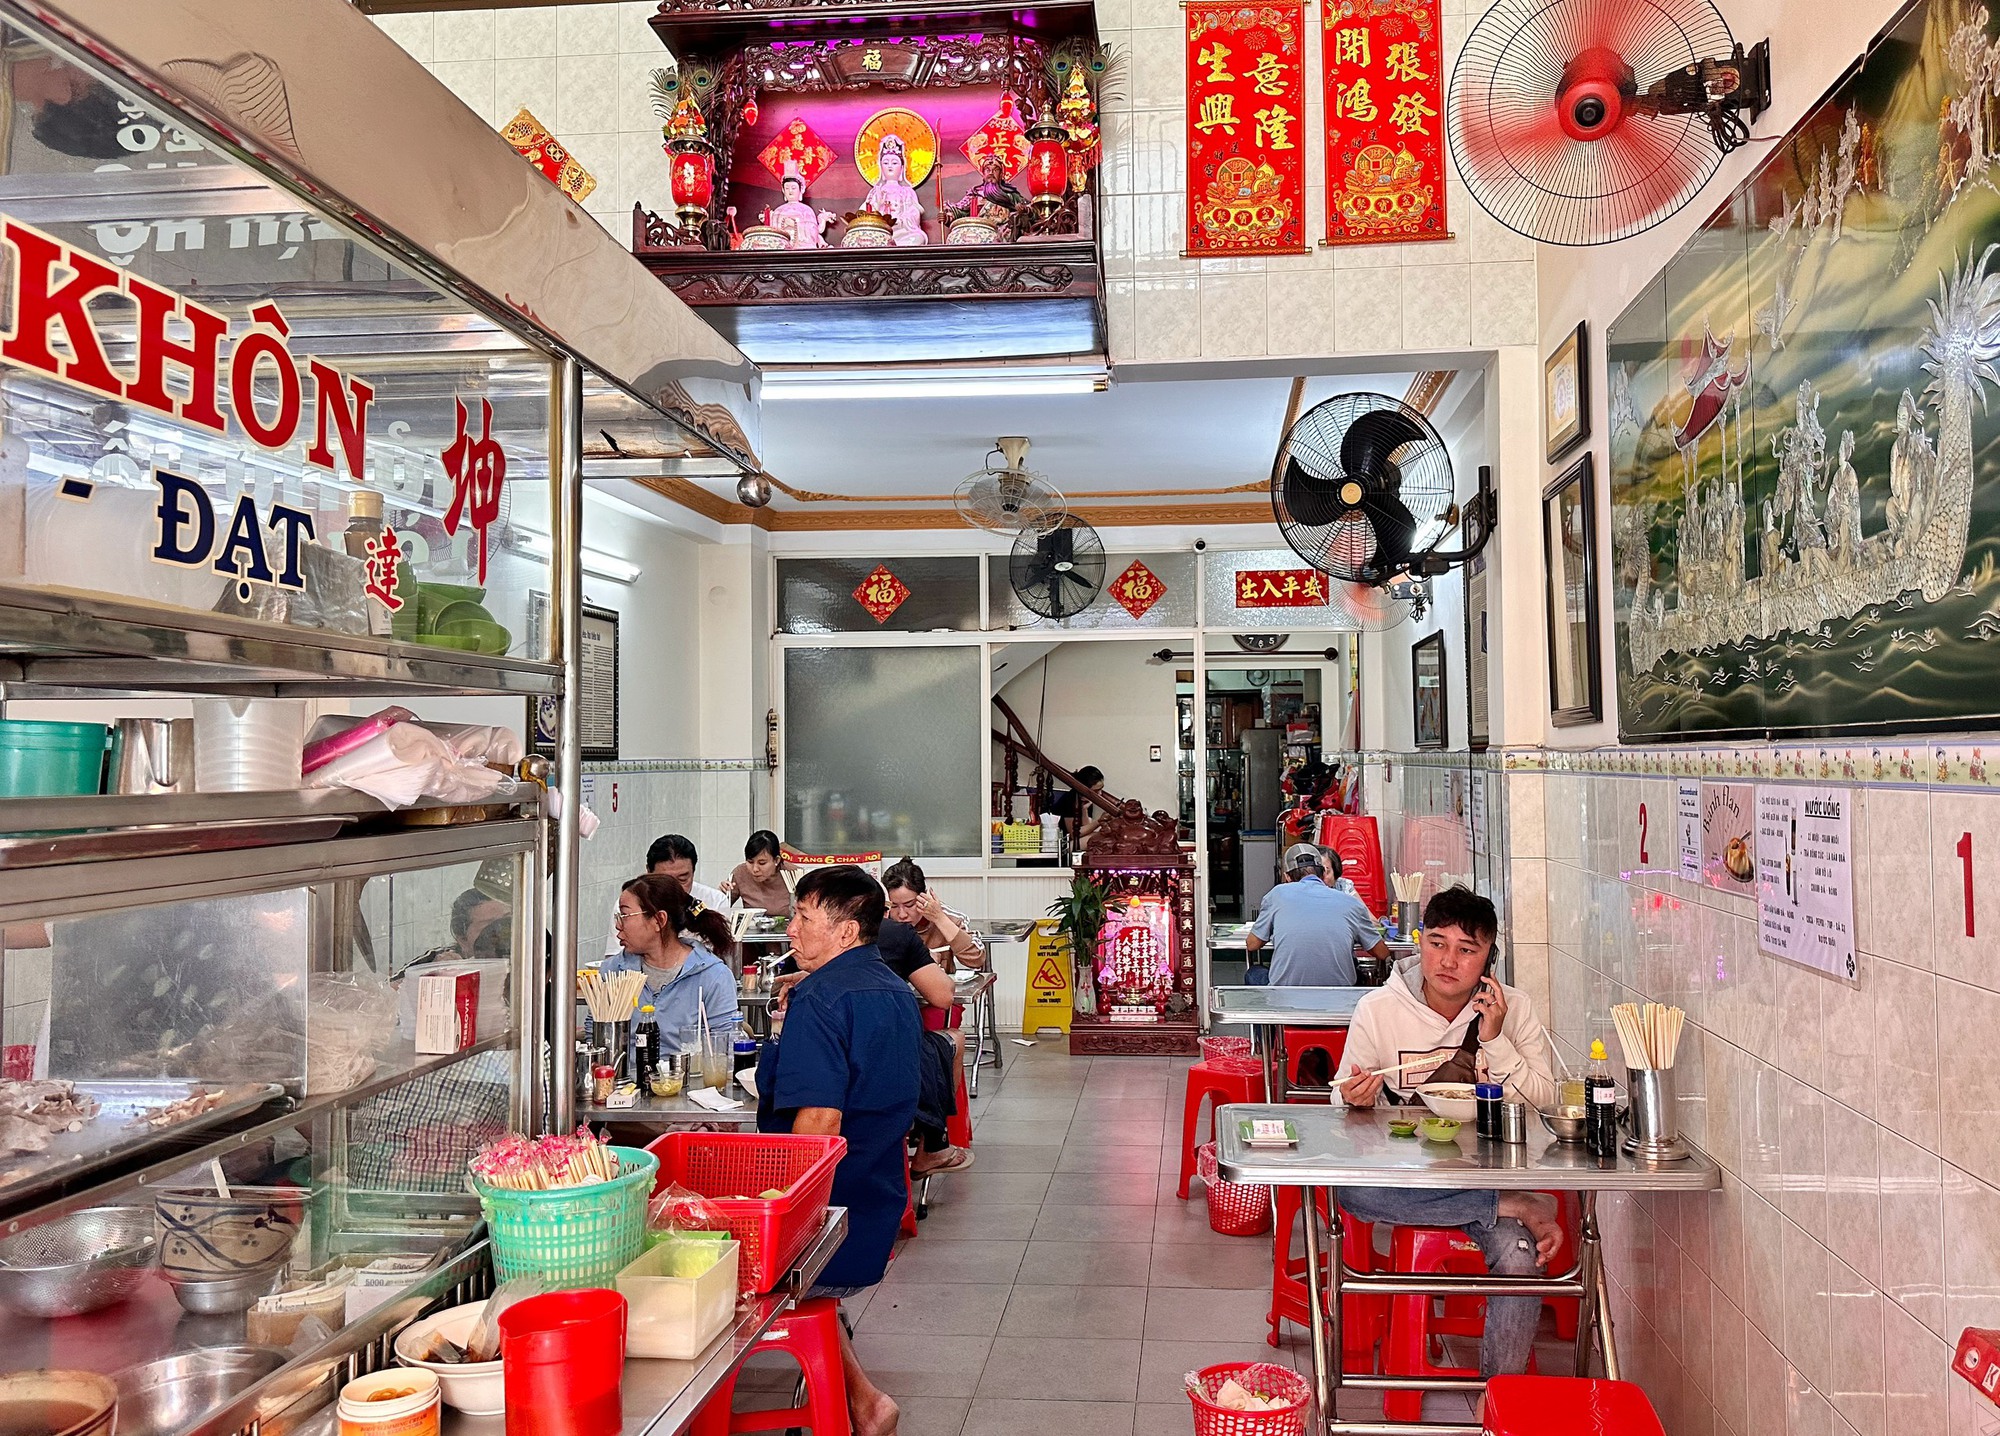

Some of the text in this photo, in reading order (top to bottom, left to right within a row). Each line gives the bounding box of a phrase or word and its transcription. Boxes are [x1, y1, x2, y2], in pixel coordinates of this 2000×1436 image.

[862, 48, 883, 72] 福
[2, 220, 374, 480] KHÔN
[153, 468, 315, 601] ĐẠT
[867, 574, 896, 604] 福
[1122, 570, 1152, 602] 福
[1241, 576, 1322, 599] 出入平安
[612, 783, 618, 812] 5
[1639, 803, 1648, 864] 2
[825, 855, 835, 865] 6
[1957, 832, 1975, 938] 1
